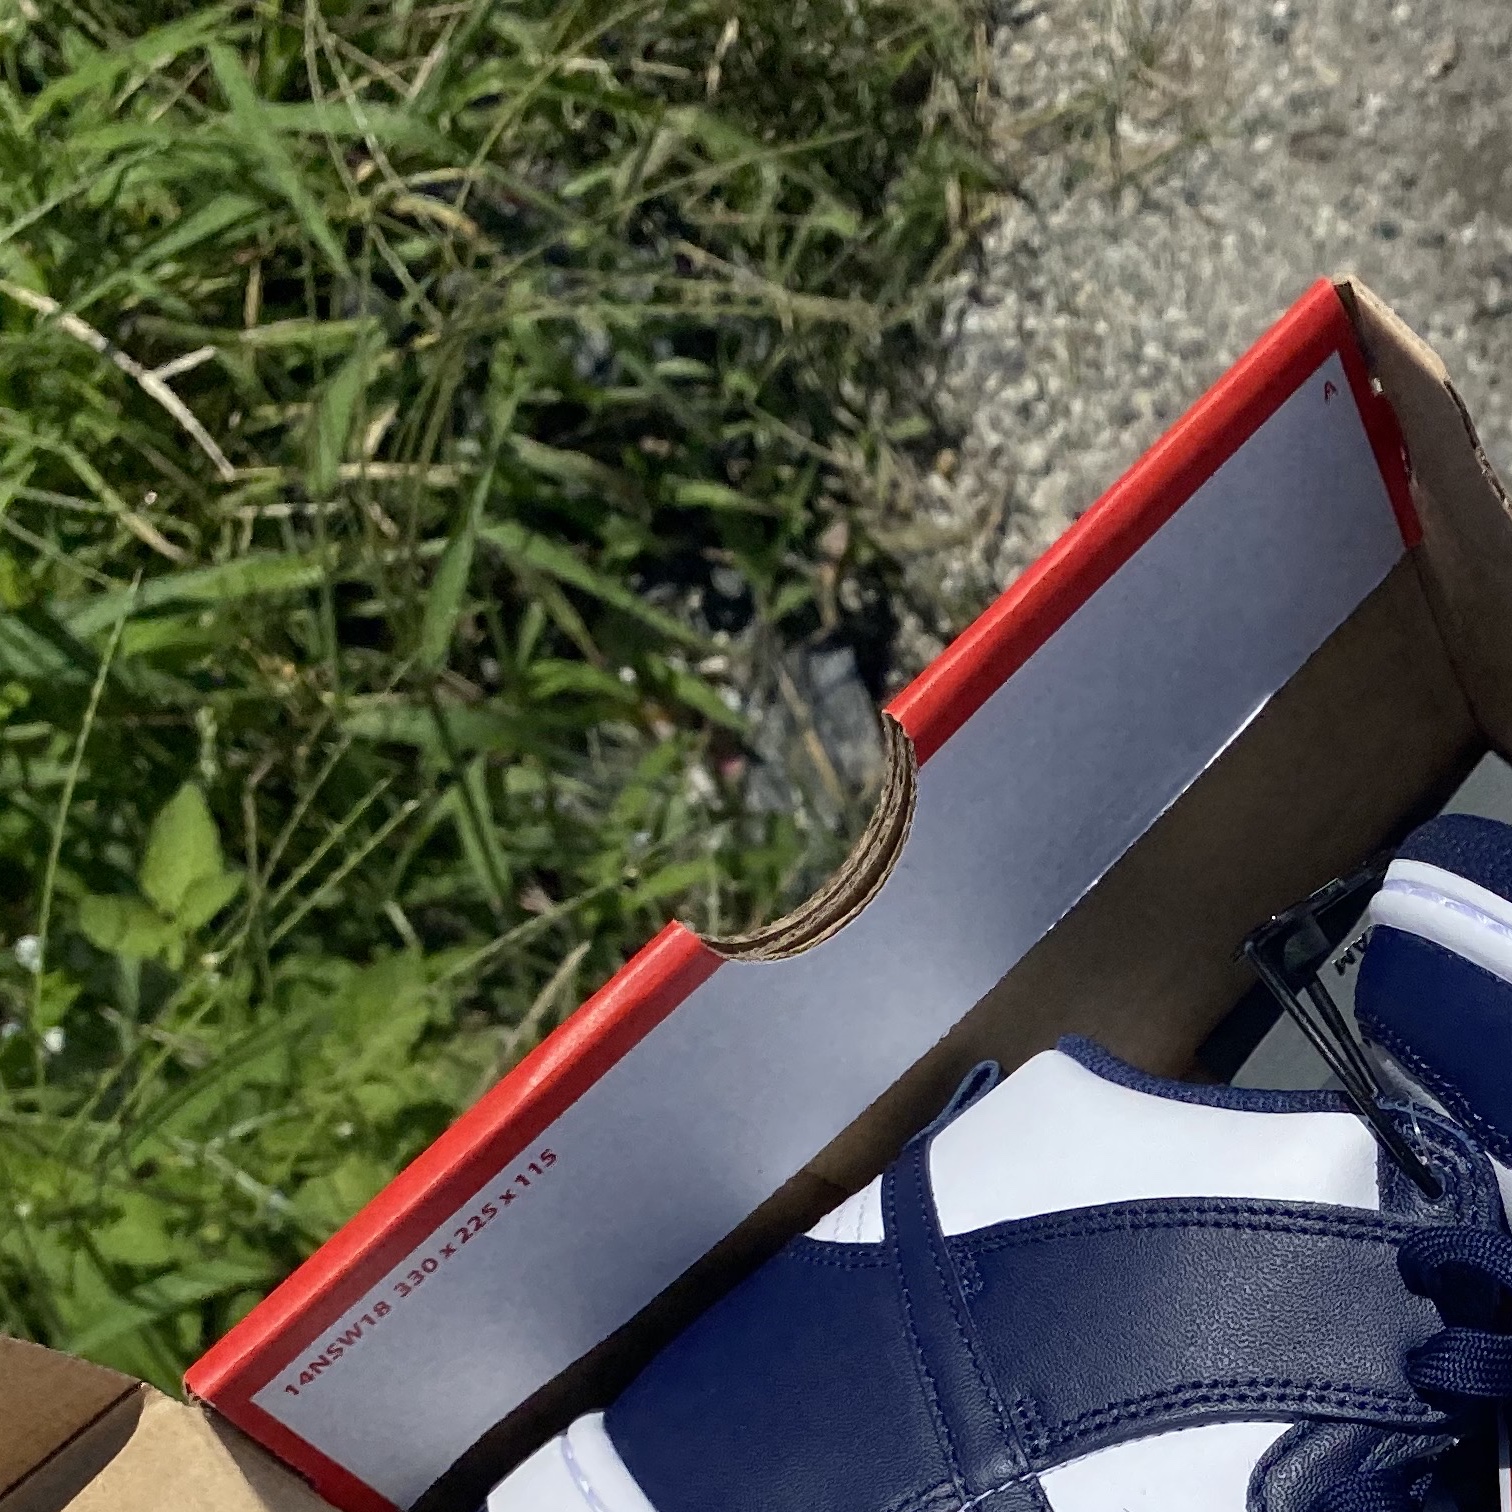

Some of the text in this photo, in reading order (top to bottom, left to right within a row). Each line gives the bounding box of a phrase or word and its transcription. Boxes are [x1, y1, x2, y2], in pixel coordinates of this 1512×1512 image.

[1323, 380, 1338, 405] A
[283, 1147, 558, 1397] 14NSW18 330 x 225 x 115
